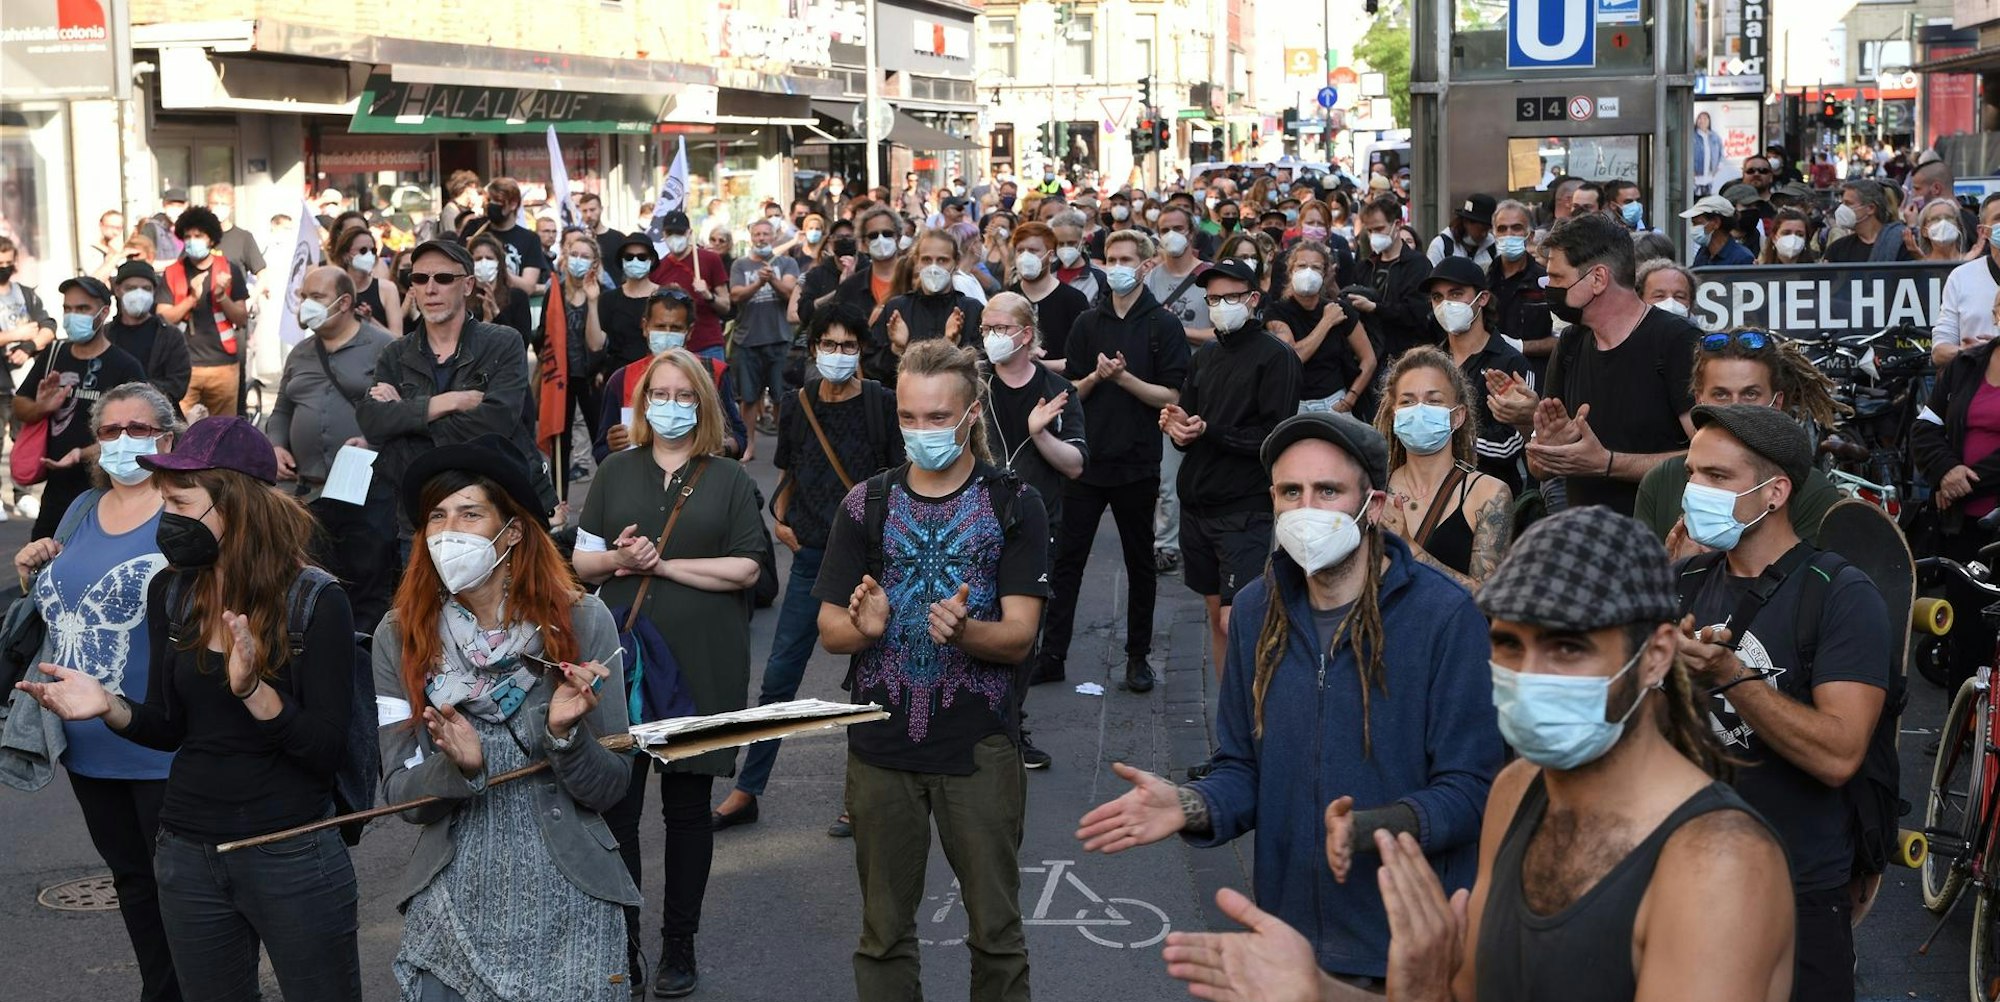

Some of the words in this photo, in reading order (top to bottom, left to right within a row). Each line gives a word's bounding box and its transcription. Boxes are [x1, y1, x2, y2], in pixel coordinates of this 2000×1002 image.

[60, 25, 105, 39] colonia
[1516, 0, 1587, 61] U
[1616, 34, 1623, 47] 1
[399, 83, 588, 119] HALALKAUF
[1522, 102, 1535, 117] 3
[1548, 101, 1560, 116] 4
